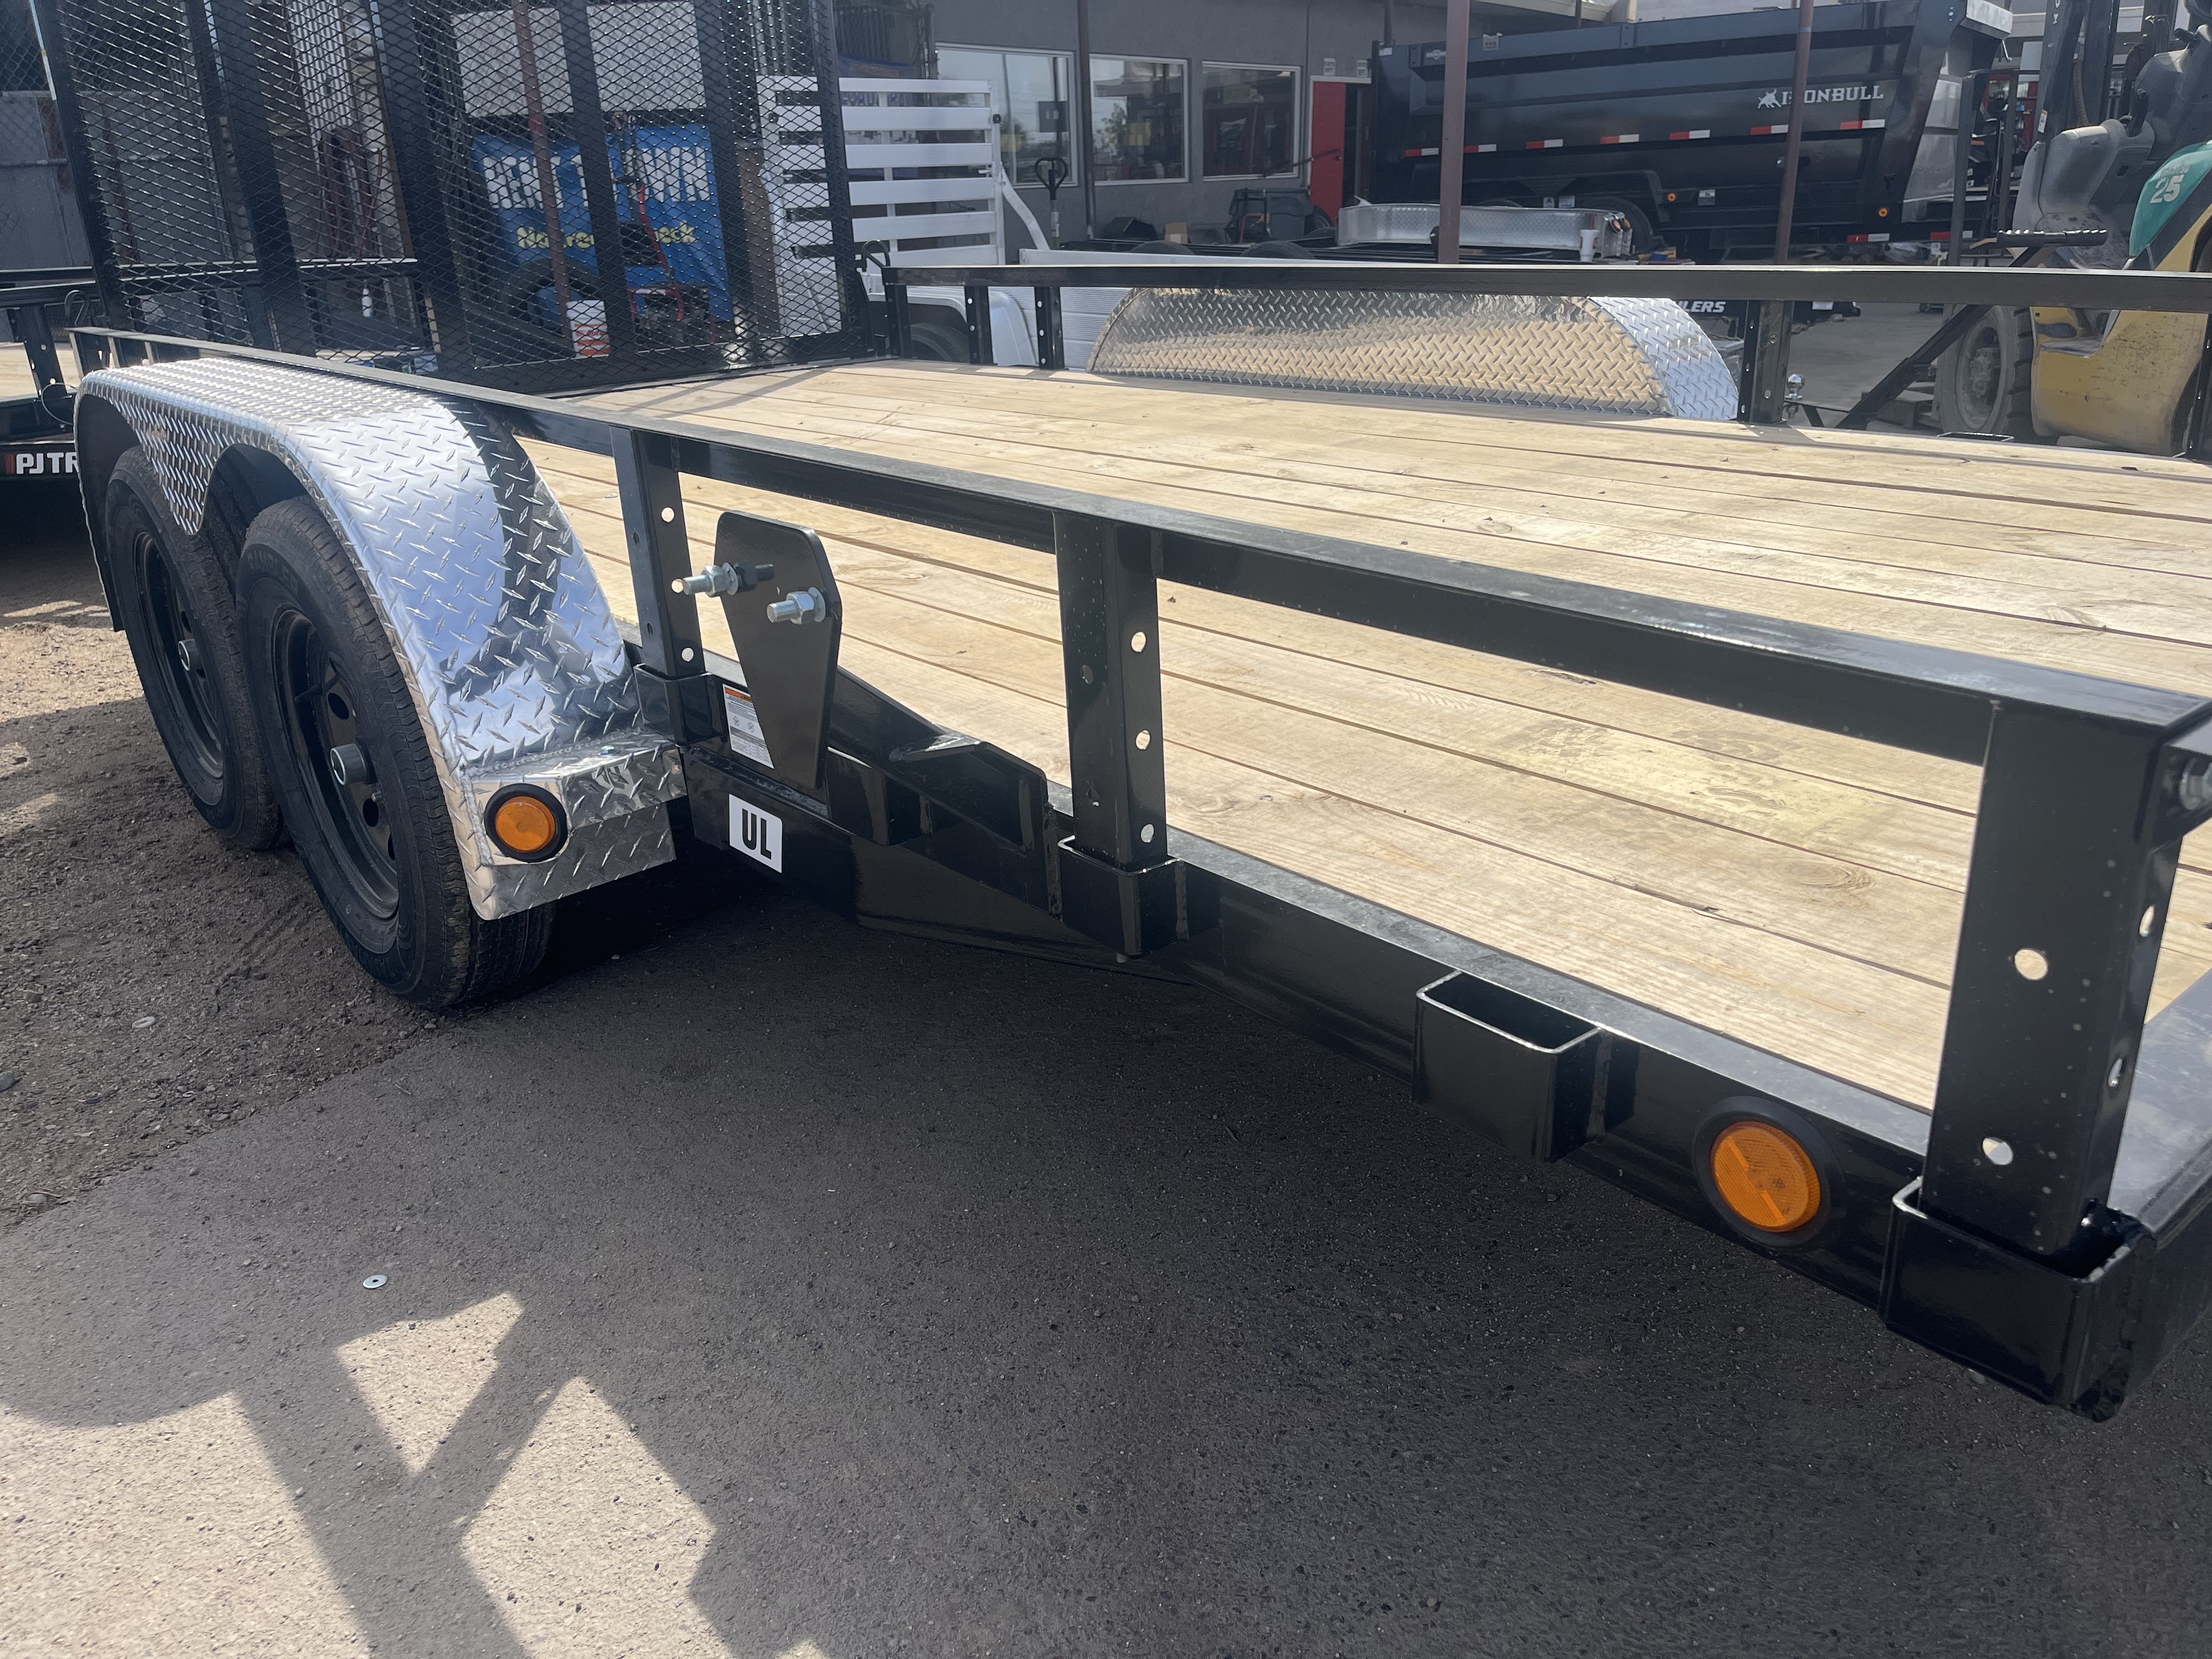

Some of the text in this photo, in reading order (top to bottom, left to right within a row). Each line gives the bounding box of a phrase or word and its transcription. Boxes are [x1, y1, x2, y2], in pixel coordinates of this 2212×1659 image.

[1781, 86, 1884, 105] IONBULL
[2150, 174, 2185, 204] 25
[16, 453, 44, 475] PJ
[742, 808, 772, 860] UL
